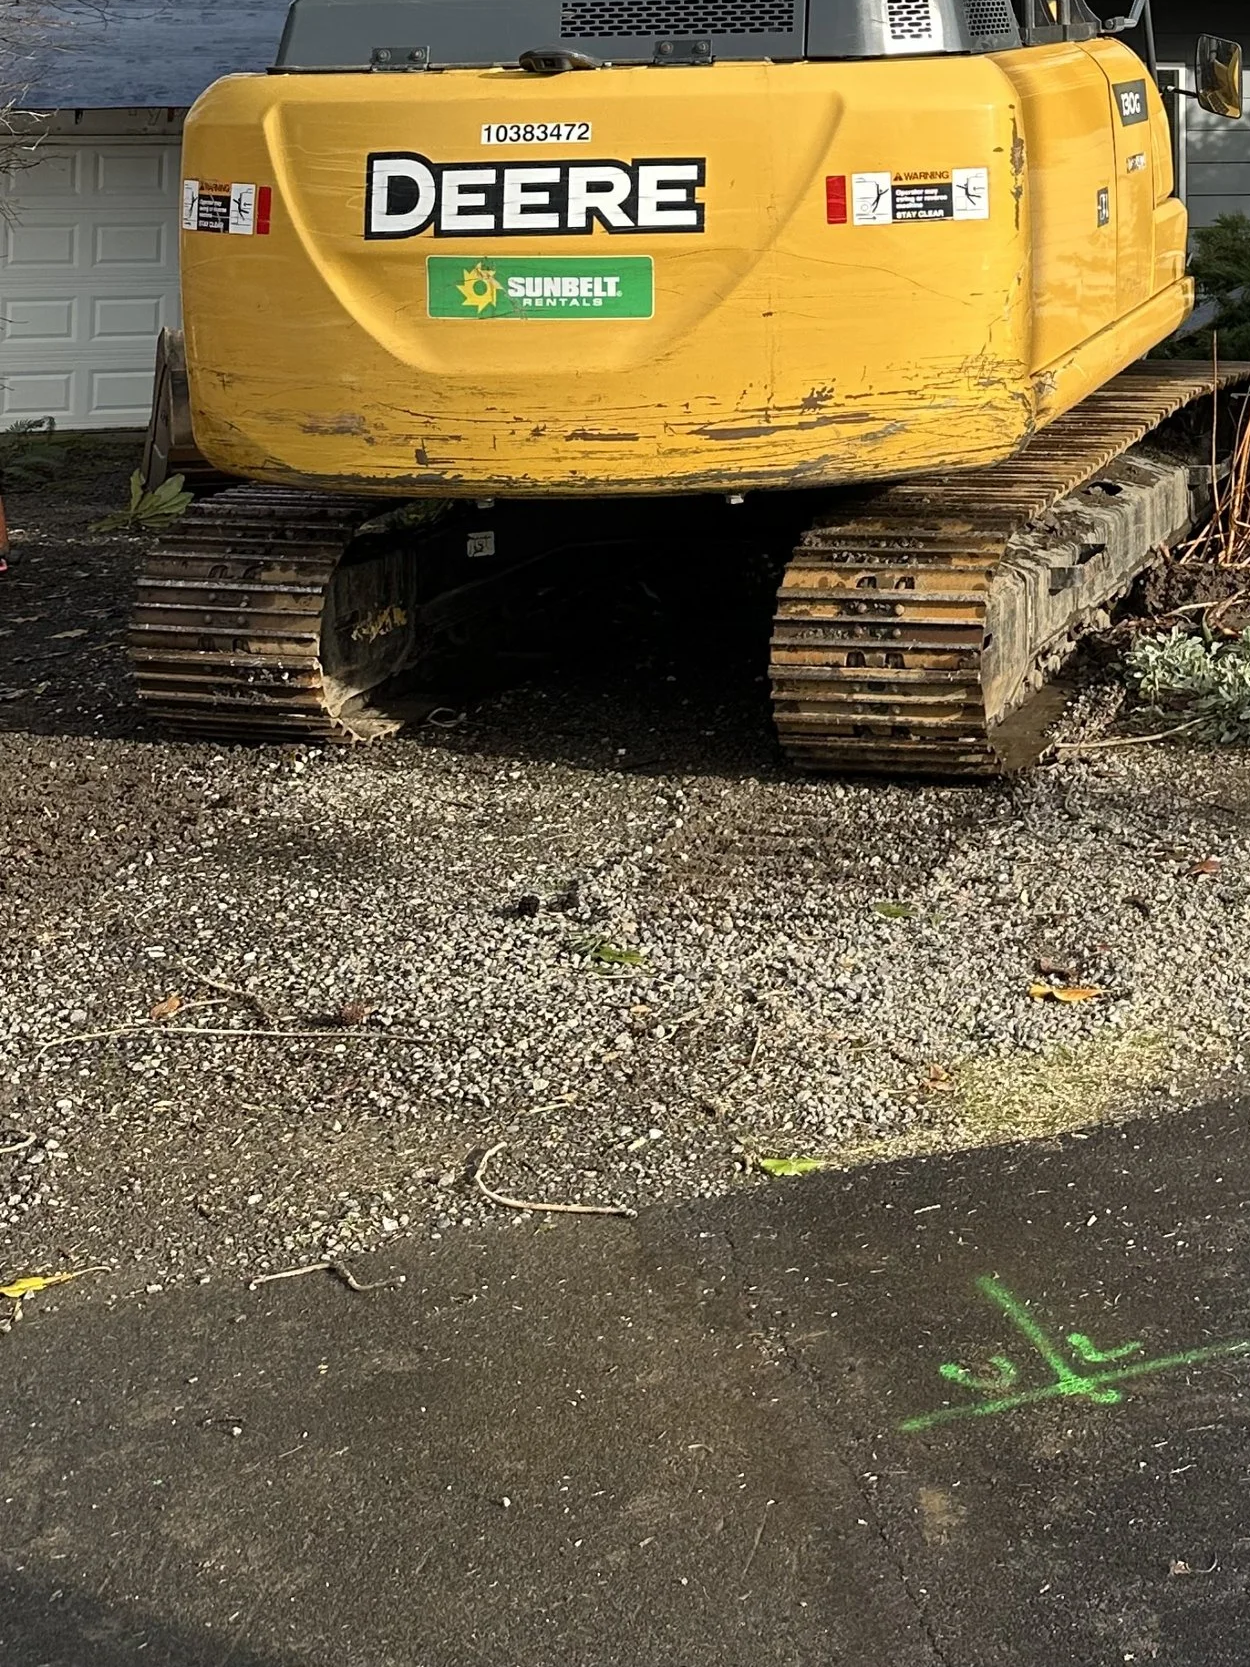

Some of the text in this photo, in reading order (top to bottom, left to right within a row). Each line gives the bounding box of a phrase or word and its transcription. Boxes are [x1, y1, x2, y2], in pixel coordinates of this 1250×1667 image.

[1120, 91, 1141, 116] 130G
[484, 122, 590, 142] 10383472
[904, 171, 949, 180] WARNING
[369, 157, 700, 234] DEERE
[896, 209, 945, 219] STAY CLEAR
[507, 276, 620, 297] SUNBELT
[522, 297, 603, 307] RENTALS
